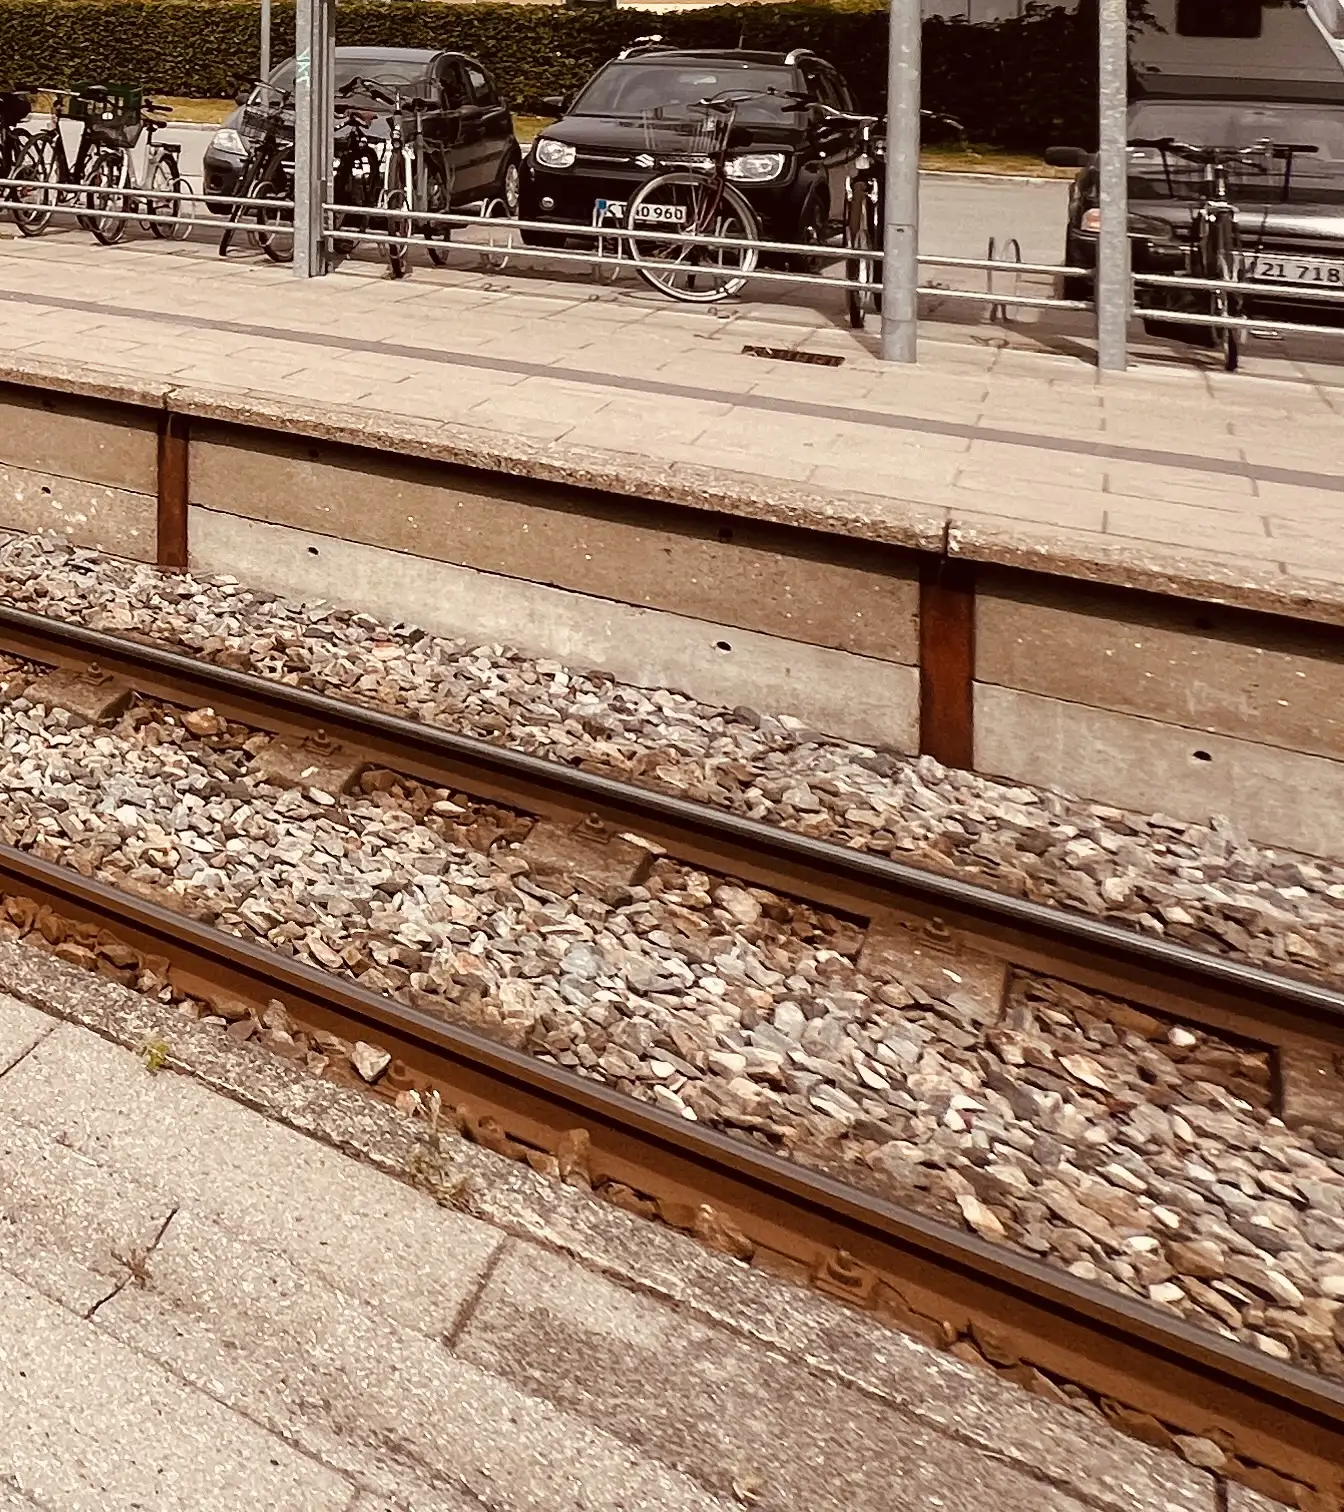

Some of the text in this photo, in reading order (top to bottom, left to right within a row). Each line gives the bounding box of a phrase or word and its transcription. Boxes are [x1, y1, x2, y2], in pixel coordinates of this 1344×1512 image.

[653, 207, 683, 220] 960
[1260, 262, 1287, 278] 21
[1295, 264, 1341, 283] 718
